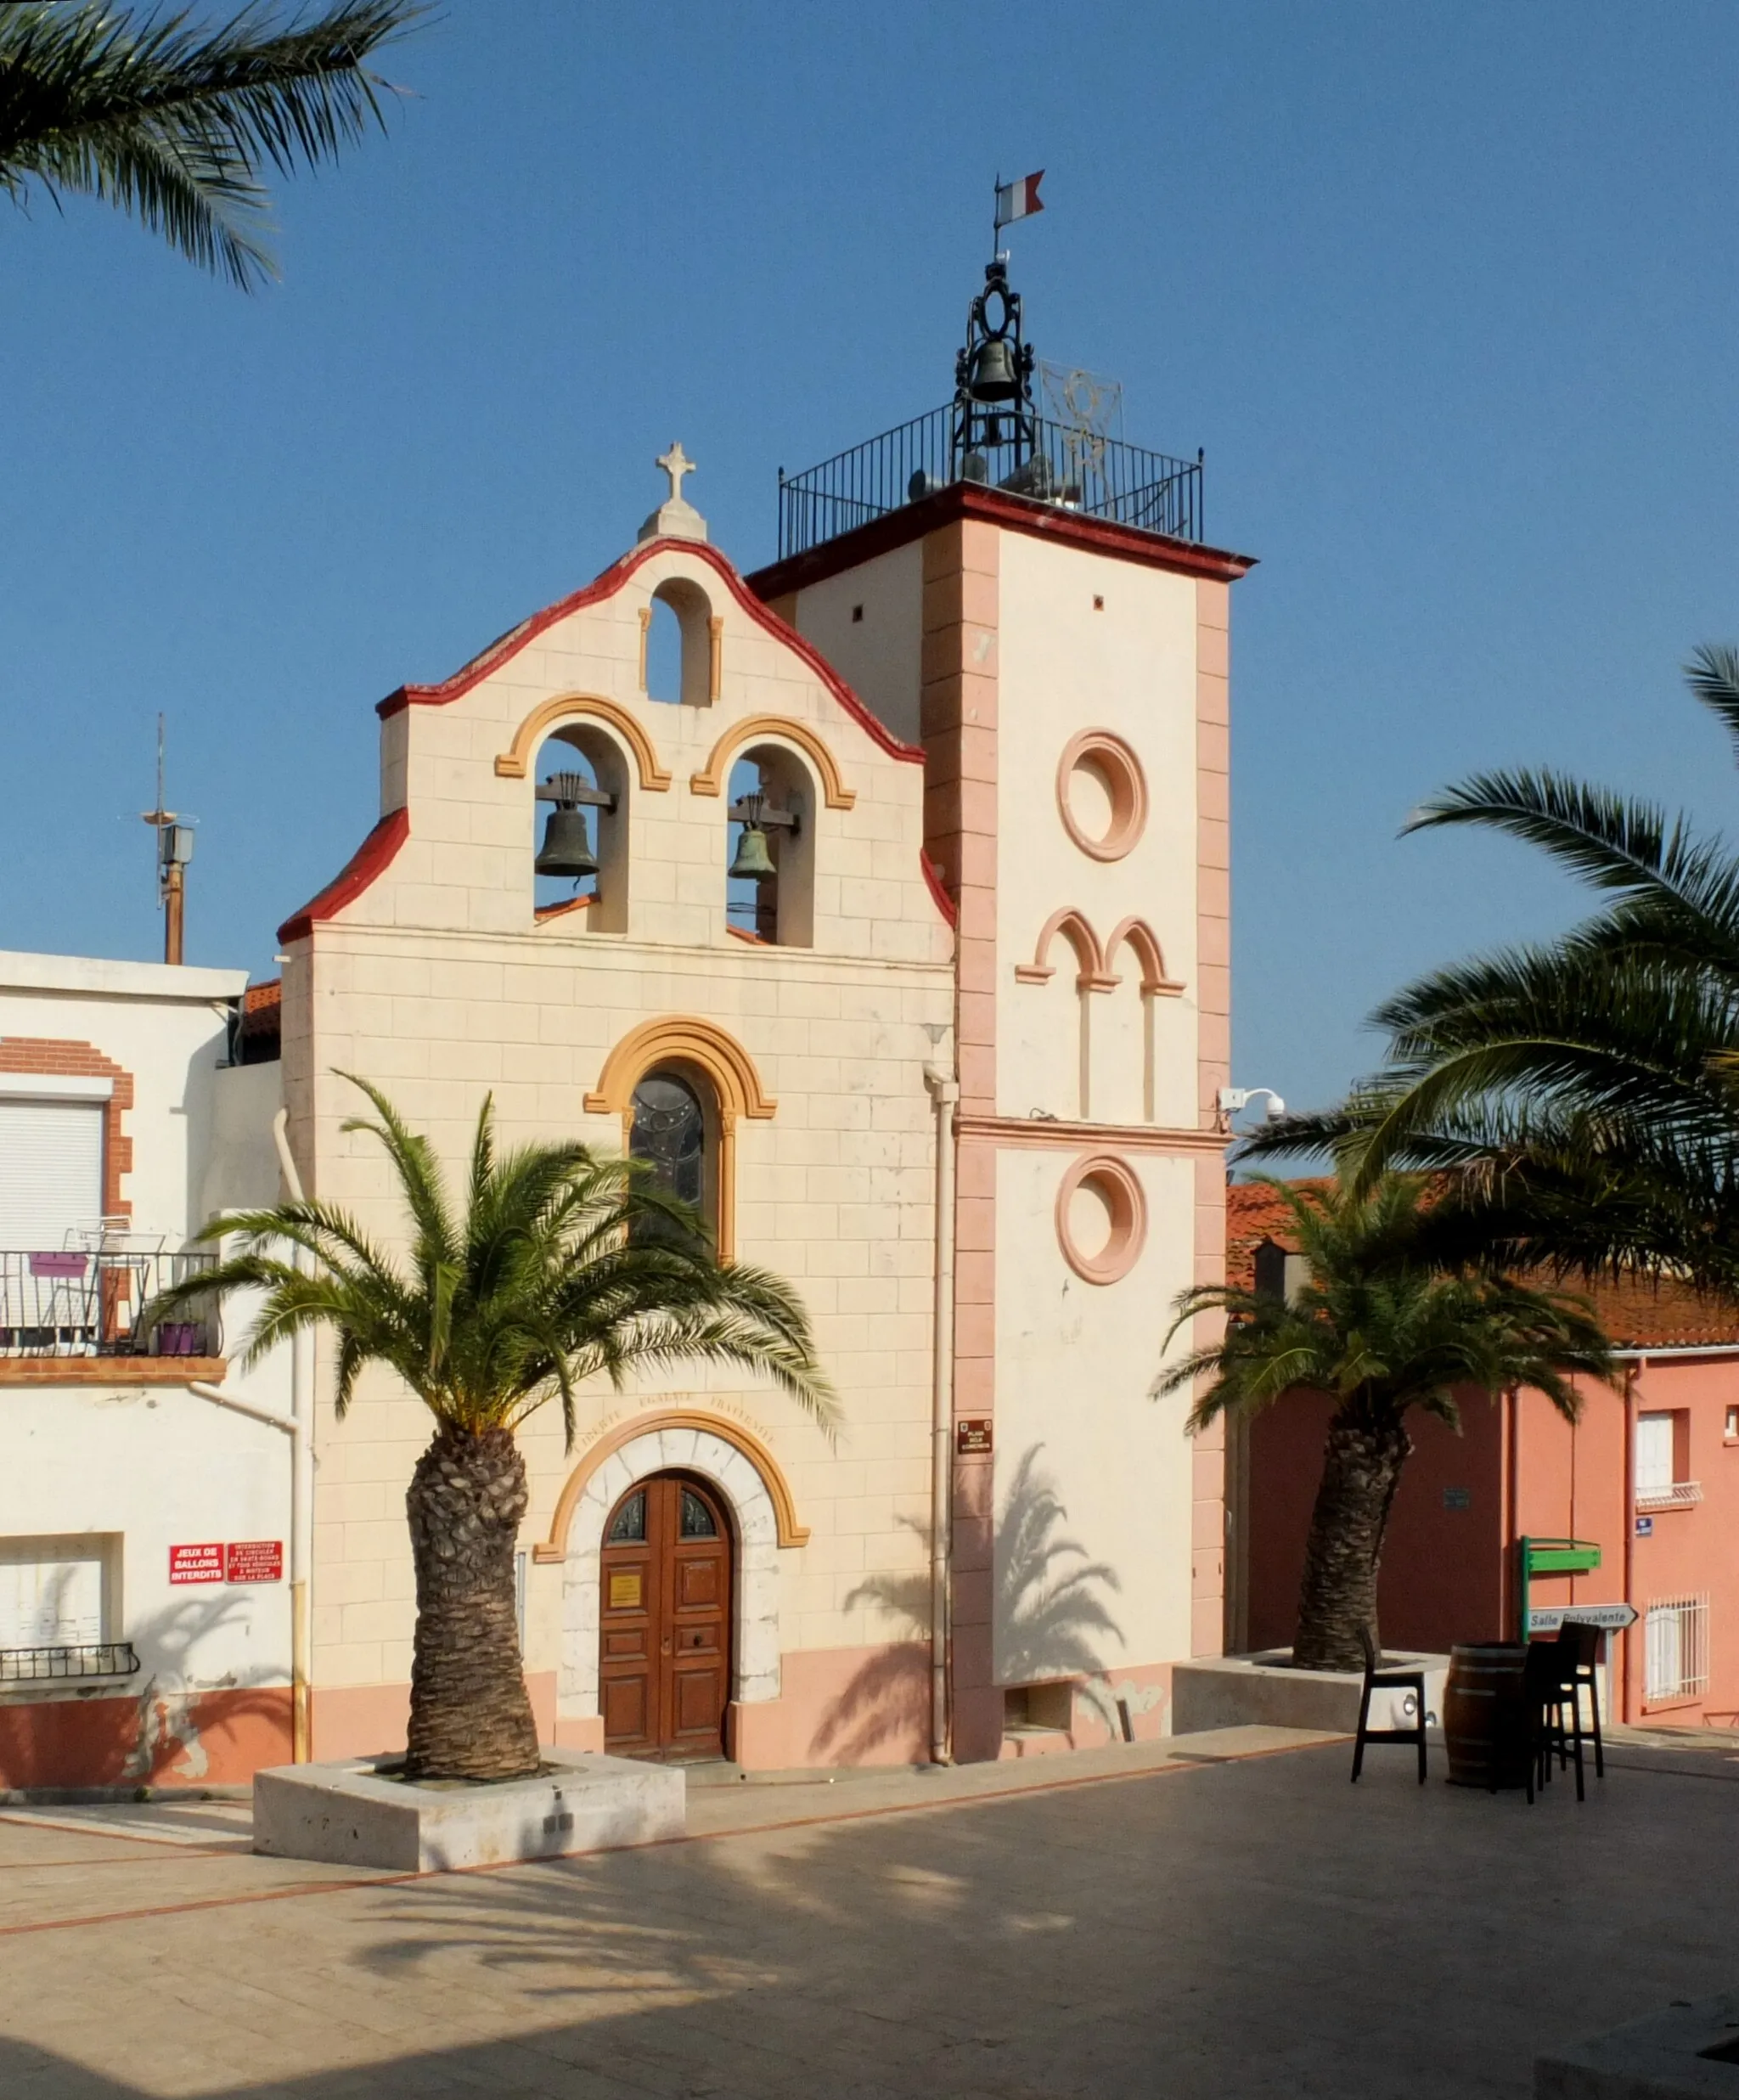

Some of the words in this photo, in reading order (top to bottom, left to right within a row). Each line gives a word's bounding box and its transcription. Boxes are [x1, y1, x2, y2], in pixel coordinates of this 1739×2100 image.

[177, 1548, 202, 1558] JEUX
[204, 1547, 217, 1556] DE
[174, 1558, 219, 1569] BALLONS
[172, 1569, 222, 1580] INTERDITS
[1531, 1613, 1558, 1626] Salle
[1562, 1612, 1626, 1624] Polyvalente
